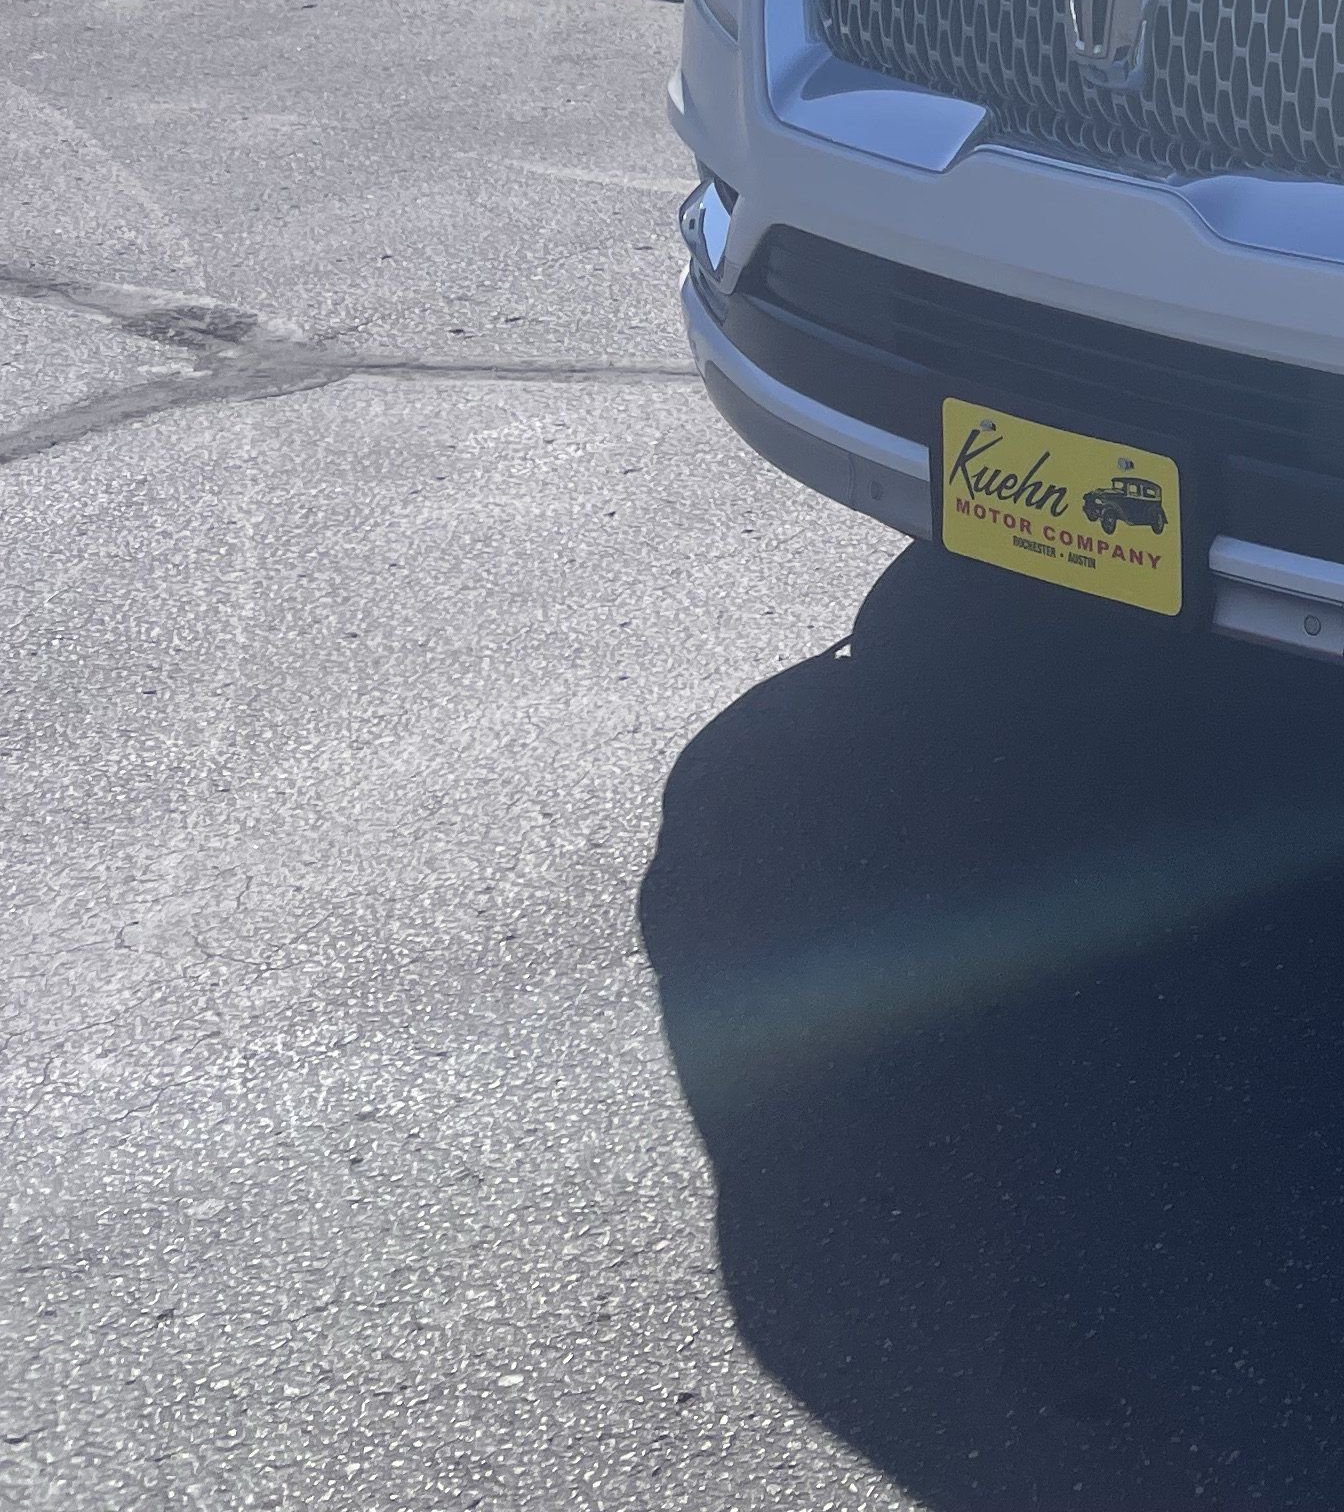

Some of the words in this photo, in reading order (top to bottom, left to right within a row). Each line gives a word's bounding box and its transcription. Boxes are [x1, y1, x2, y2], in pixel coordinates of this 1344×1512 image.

[949, 428, 1069, 518] Kuehn
[956, 497, 1032, 535] MOTOR
[1043, 525, 1162, 570] COMPANY
[1013, 535, 1056, 558] ROCHESTER
[1068, 551, 1096, 569] AUSTIN
